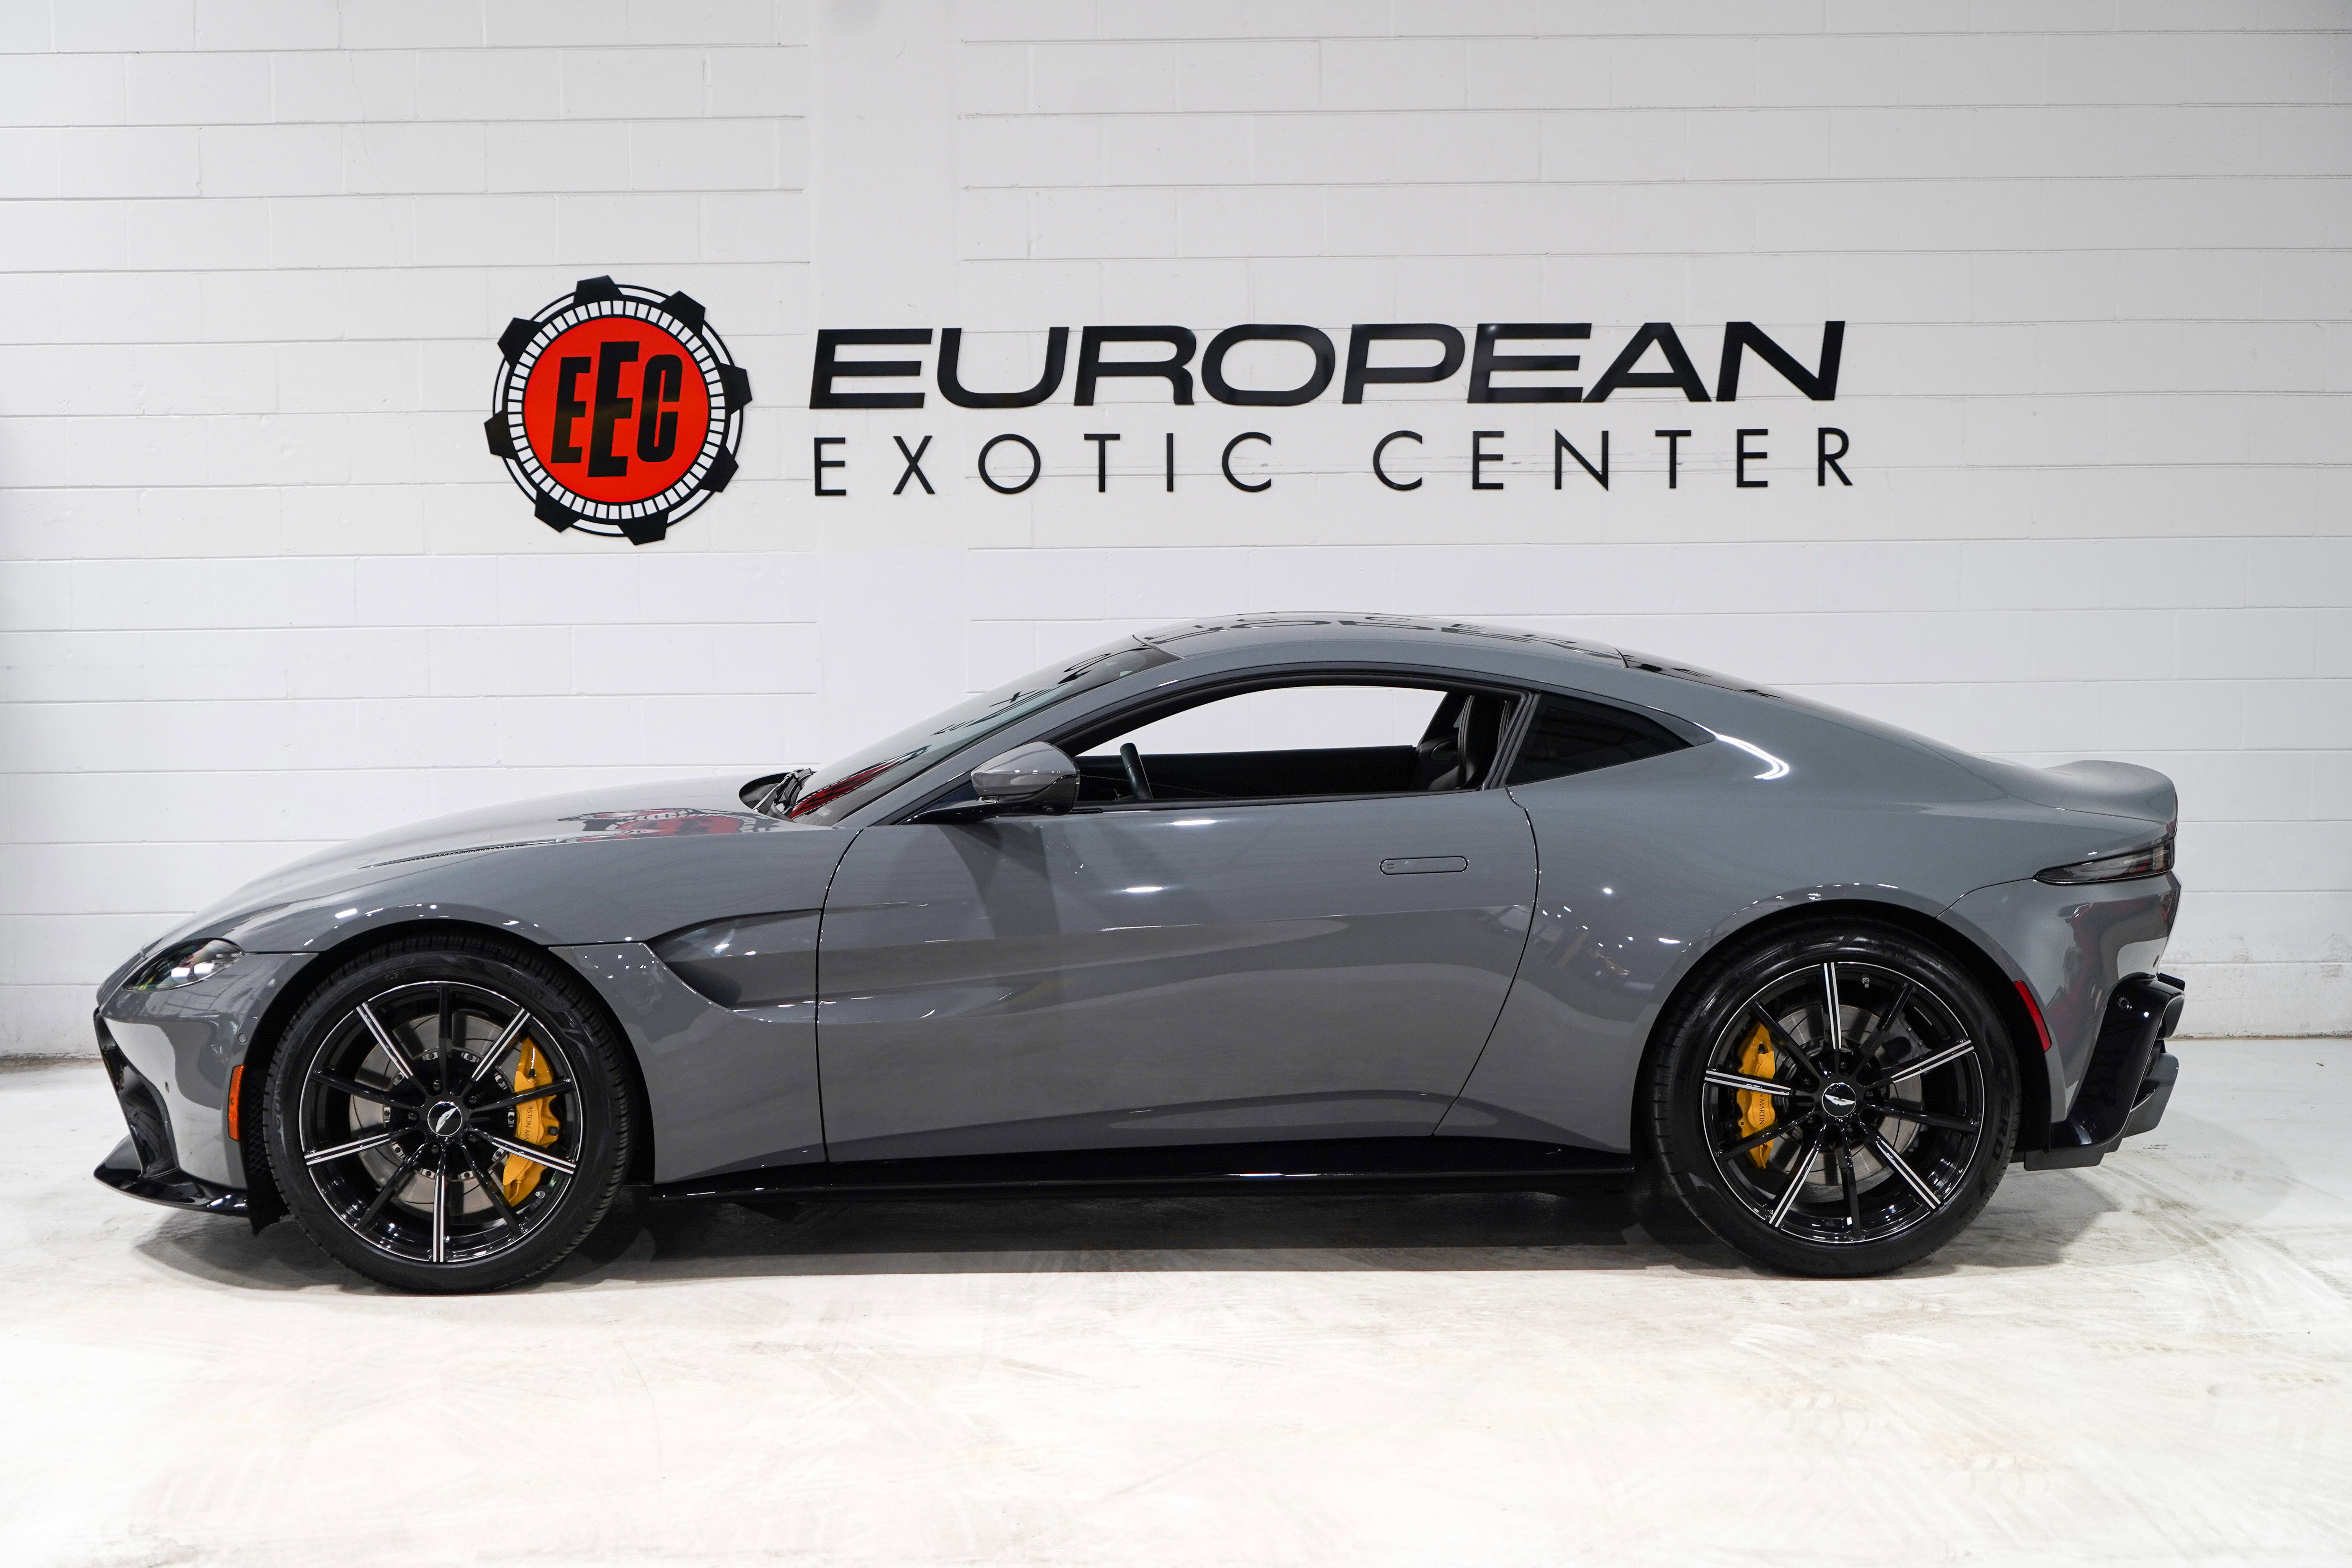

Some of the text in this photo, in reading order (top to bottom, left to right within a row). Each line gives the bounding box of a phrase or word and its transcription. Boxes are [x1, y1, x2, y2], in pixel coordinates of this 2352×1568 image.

[551, 341, 683, 477] EEC
[809, 321, 1845, 409] EUROPEAN
[814, 428, 1853, 496] EXOTIC CENTER
